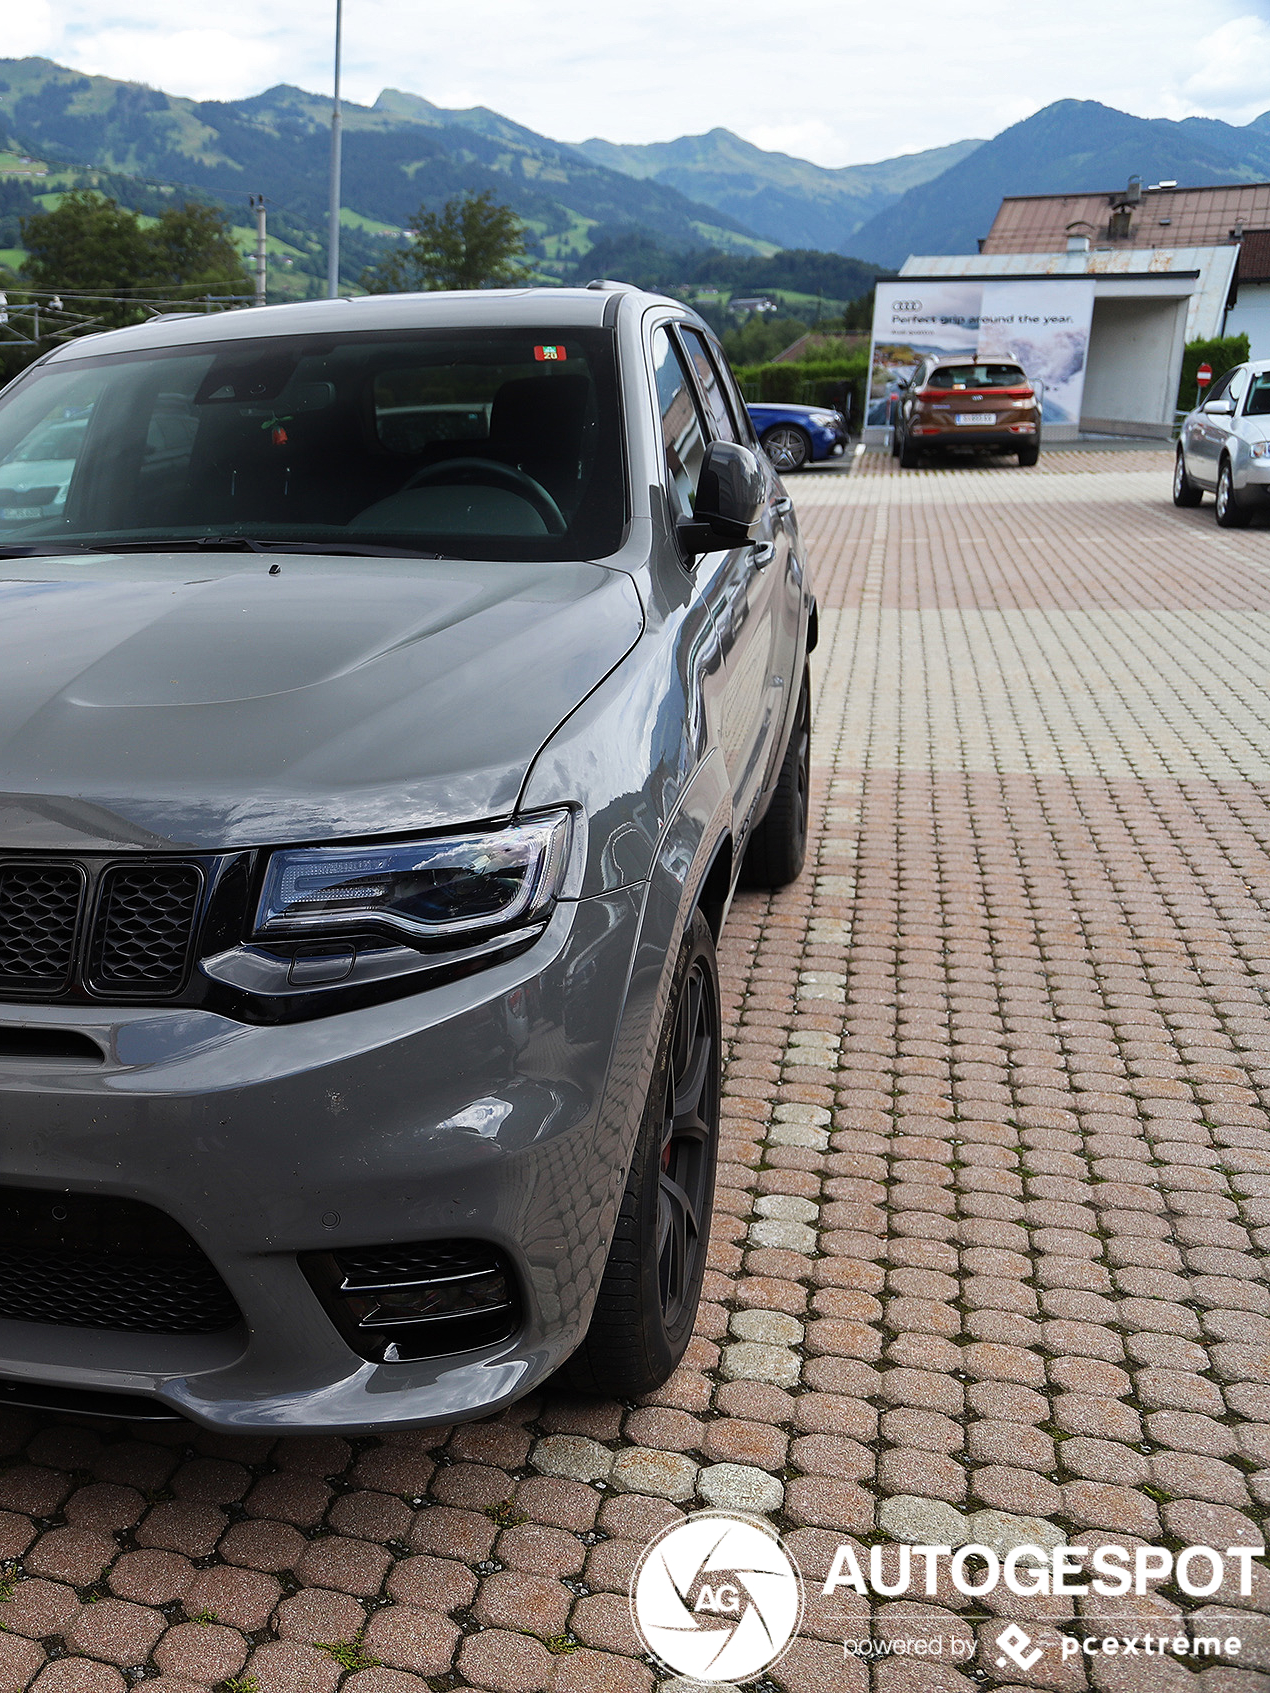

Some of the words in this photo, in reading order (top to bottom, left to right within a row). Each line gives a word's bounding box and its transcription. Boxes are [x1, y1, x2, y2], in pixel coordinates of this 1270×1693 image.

[891, 314, 937, 325] Perfect
[939, 314, 966, 326] grip
[968, 314, 1015, 325] around
[1018, 314, 1040, 324] the
